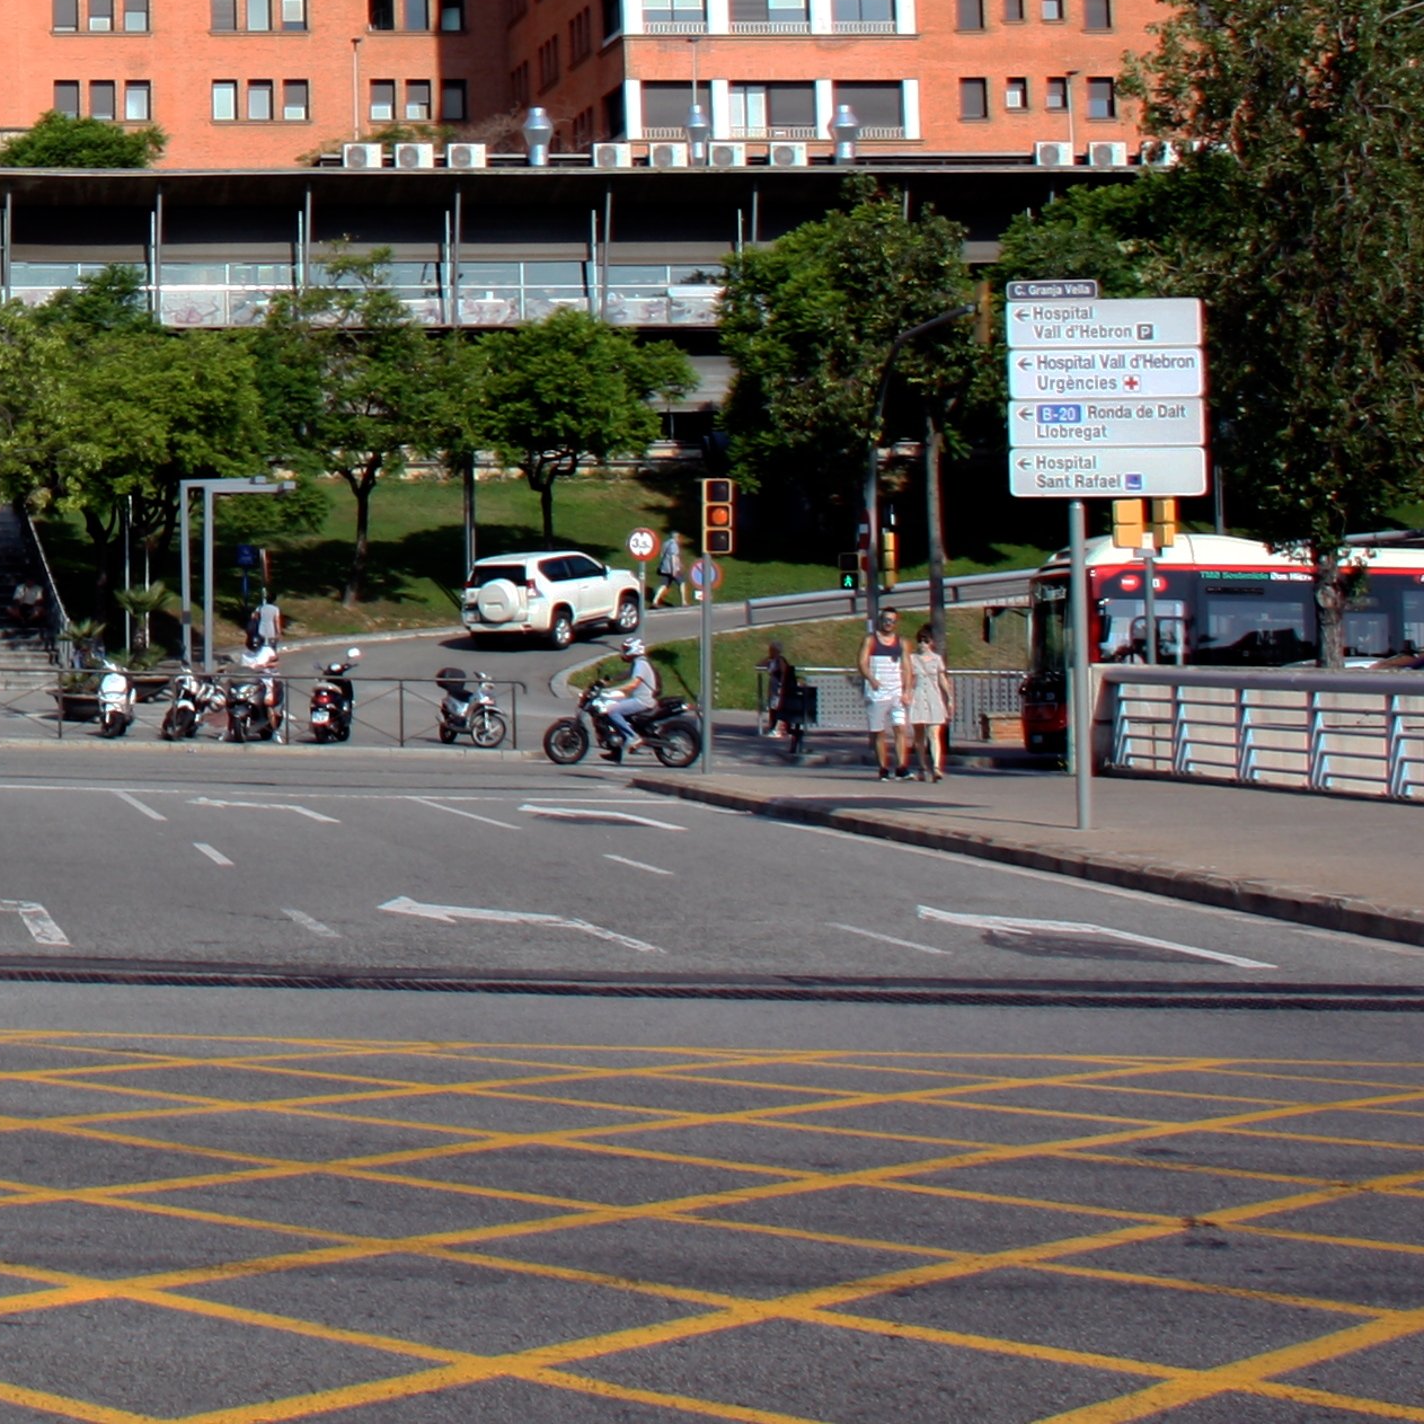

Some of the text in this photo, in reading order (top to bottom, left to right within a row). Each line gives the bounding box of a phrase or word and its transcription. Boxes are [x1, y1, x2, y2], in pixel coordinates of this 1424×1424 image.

[1014, 283, 1090, 297] C. Granja Vella
[1033, 306, 1093, 322] Hospital
[1034, 325, 1061, 338] Vall
[1065, 324, 1133, 338] d'Hebron
[1036, 353, 1195, 372] Hospital Vall d'Hebron
[1037, 375, 1118, 393] Urgències
[1042, 404, 1186, 421] B-20 Ronda de Dalt
[1036, 425, 1108, 441] Llobregat
[1036, 455, 1097, 470] Hospital
[1036, 474, 1121, 488] Sant Rafael
